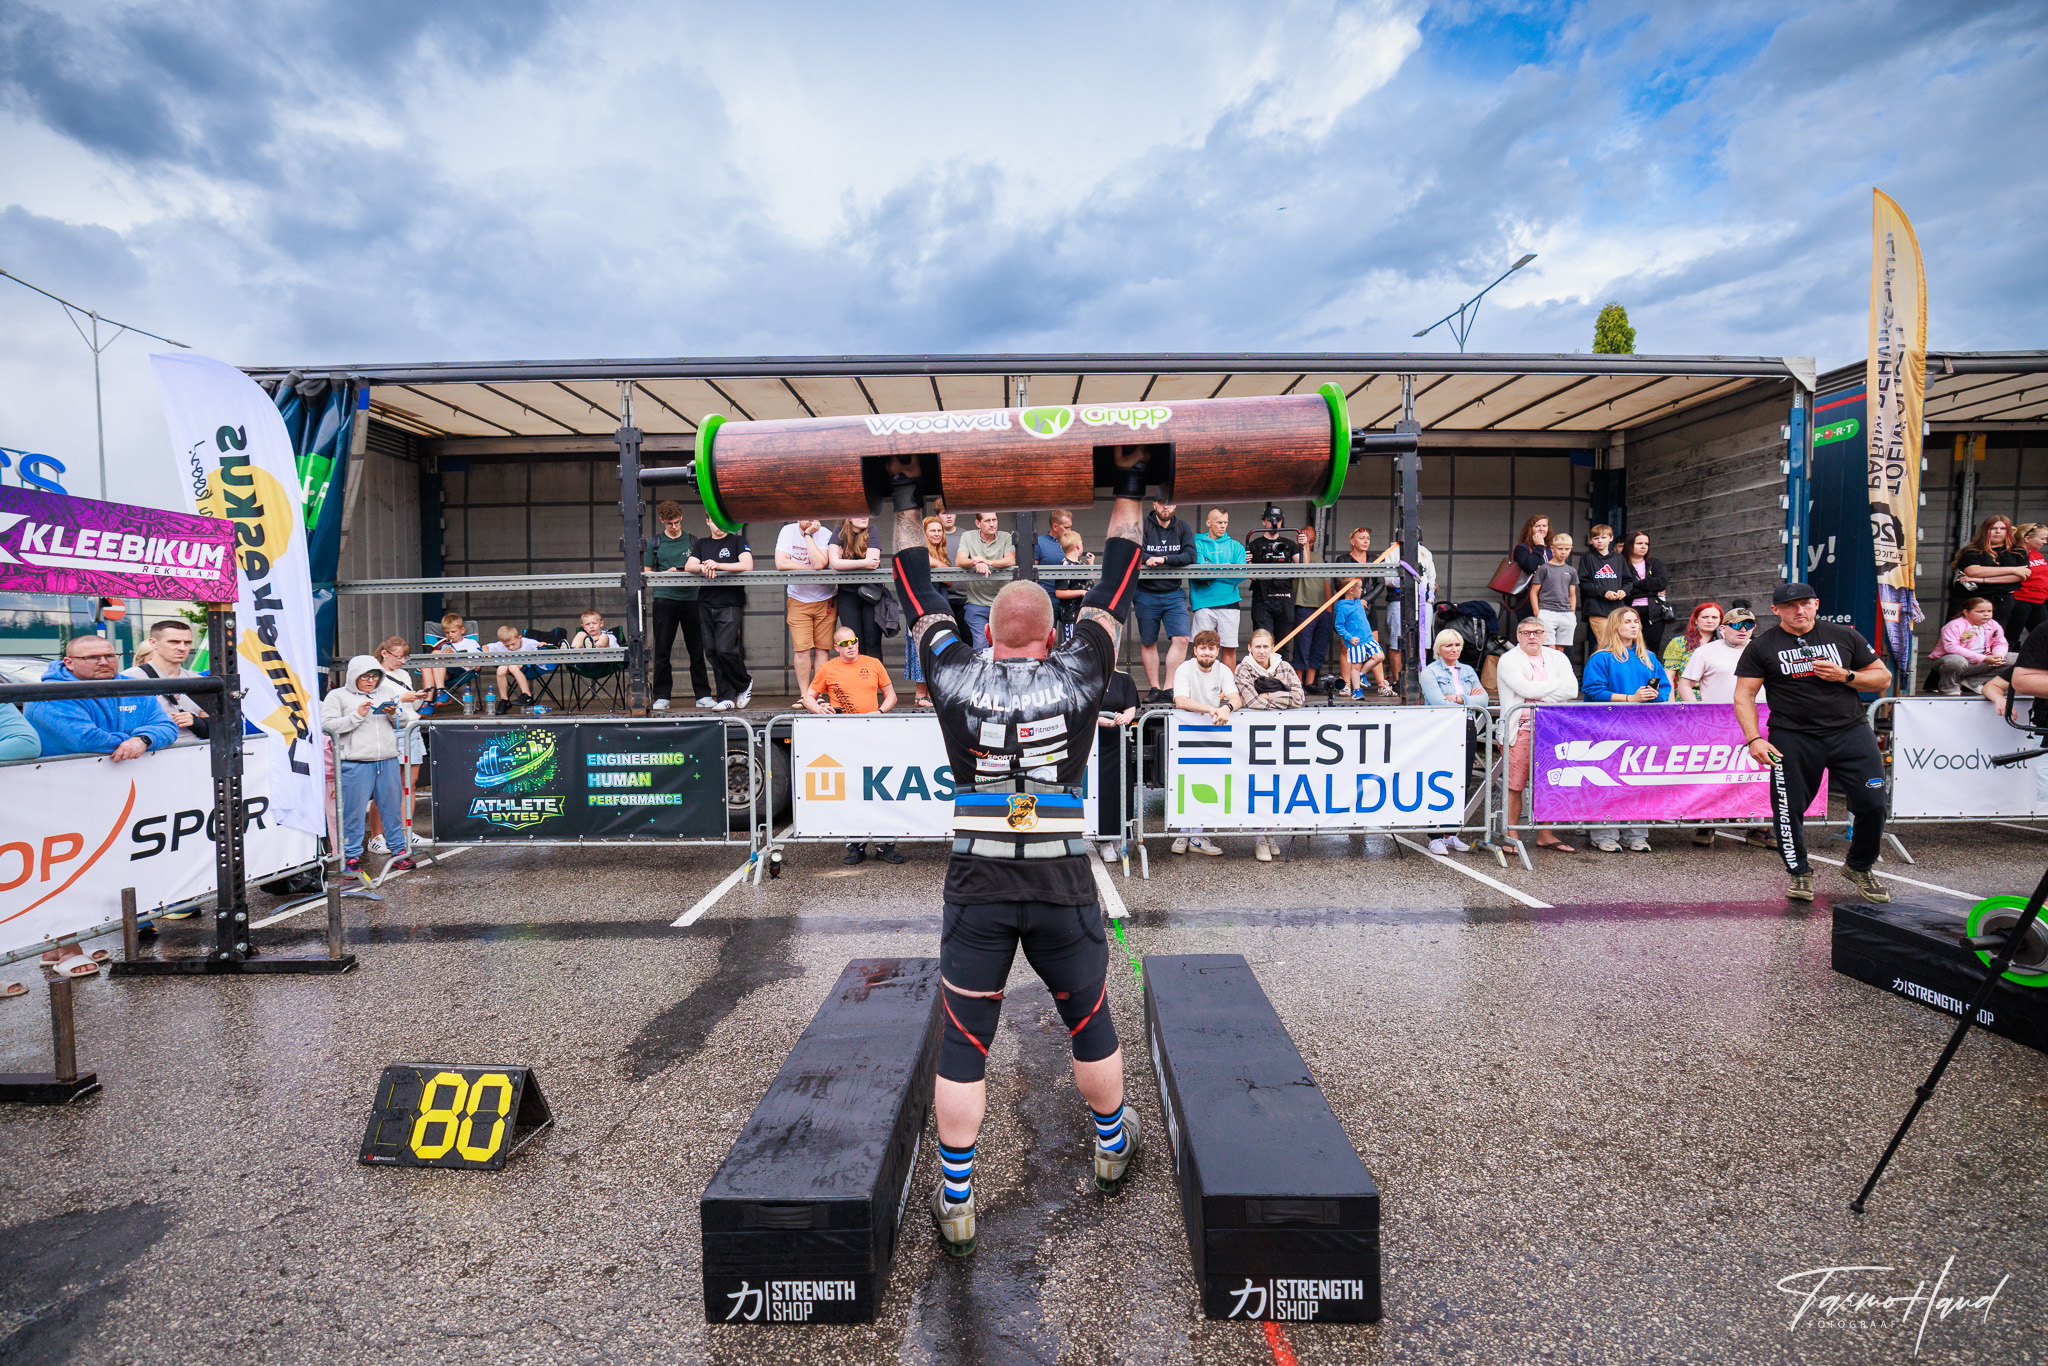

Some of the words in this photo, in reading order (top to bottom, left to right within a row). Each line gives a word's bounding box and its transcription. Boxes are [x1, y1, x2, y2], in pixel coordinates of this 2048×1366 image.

[868, 411, 1009, 433] Woodwell
[1083, 407, 1168, 428] Grupp
[20, 522, 225, 569] KLEEBIKUM
[142, 565, 215, 578] REKLAAM
[969, 683, 1068, 712] KALJAPULK
[1248, 723, 1392, 766] EESTI
[586, 753, 685, 766] ENGINEERING
[1618, 744, 1771, 773] KLEEBIK
[587, 772, 652, 787] HUMAN
[1725, 774, 1771, 782] REKL
[588, 794, 683, 806] PERFORMANCE
[1247, 770, 1456, 815] HALDUS
[473, 798, 558, 814] ATHLETE
[491, 812, 540, 822] BYTES
[1780, 824, 1798, 870] ESTONIA
[1908, 980, 1963, 1015] STRENGTH
[409, 1072, 513, 1162] 80
[771, 1280, 856, 1301] STRENGTH
[1276, 1279, 1363, 1300] STRENGTH
[772, 1301, 813, 1321] SHOP
[1276, 1300, 1319, 1321] SHOP
